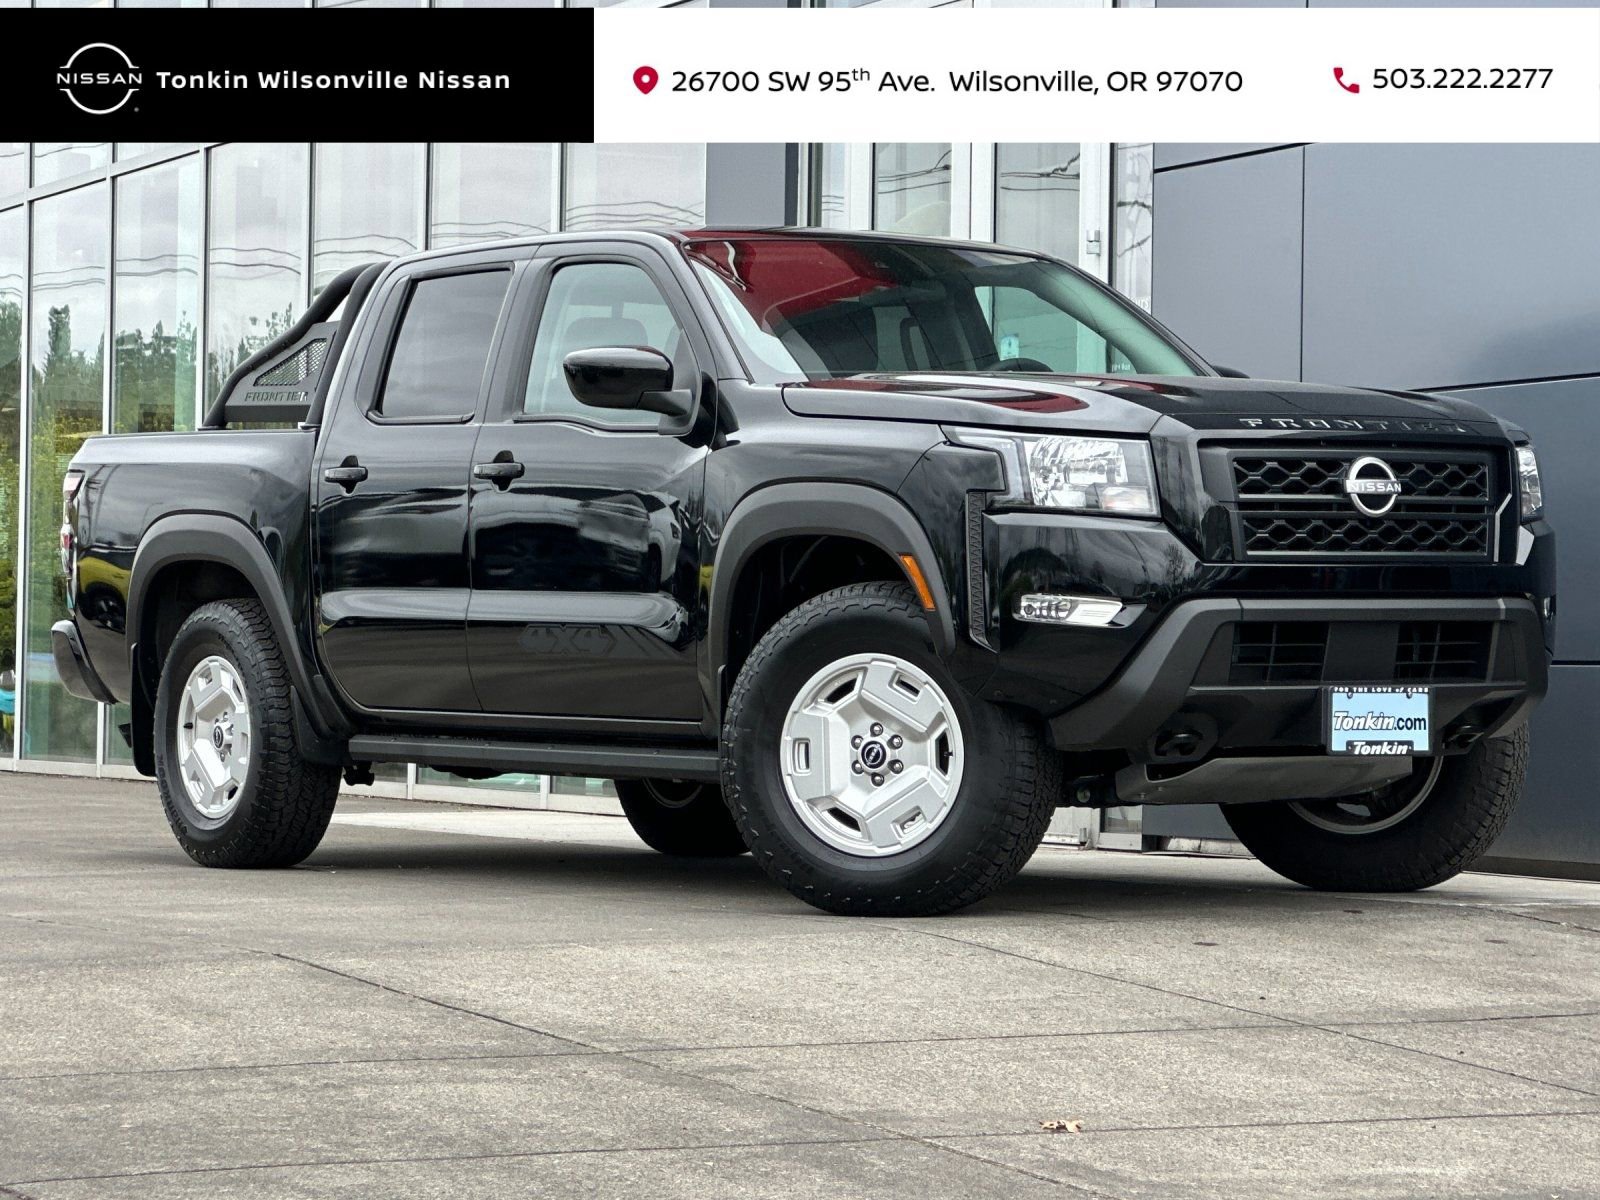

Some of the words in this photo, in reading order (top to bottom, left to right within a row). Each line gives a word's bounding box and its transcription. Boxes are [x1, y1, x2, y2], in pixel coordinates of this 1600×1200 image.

[244, 391, 308, 402] FRONTIER
[1349, 481, 1402, 493] NISSAN
[1334, 711, 1427, 731] Tonkin.com
[1353, 741, 1408, 755] Tonkin
